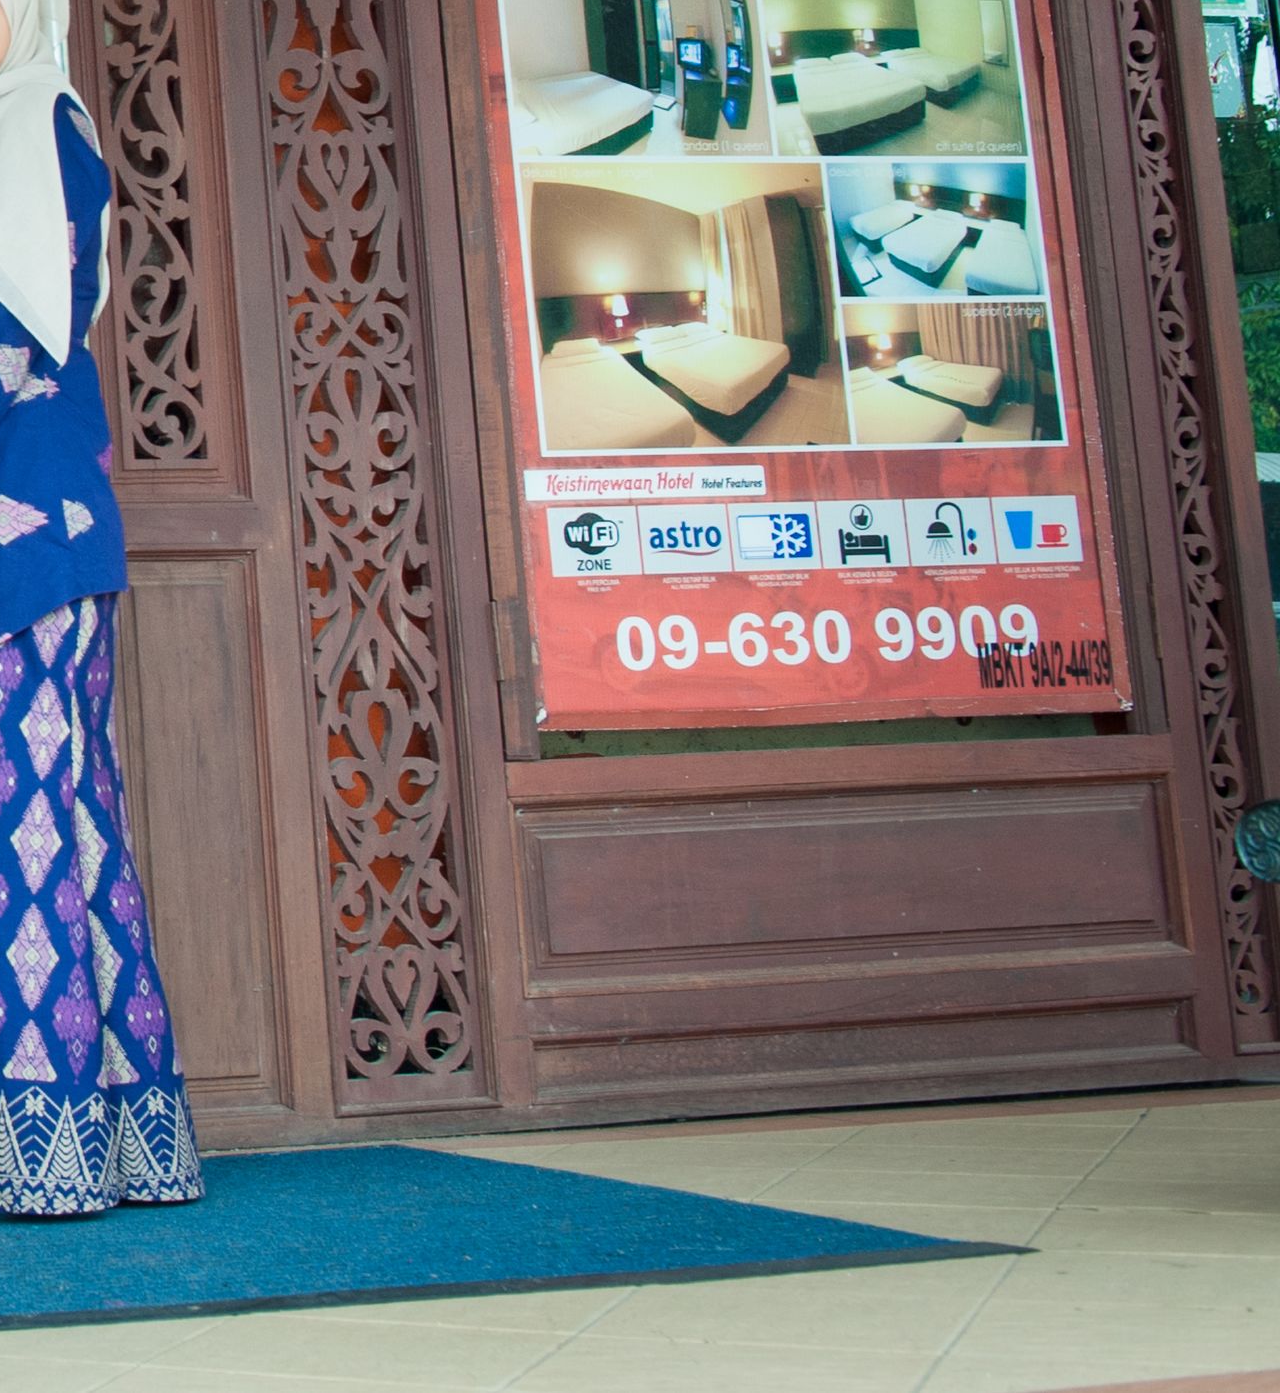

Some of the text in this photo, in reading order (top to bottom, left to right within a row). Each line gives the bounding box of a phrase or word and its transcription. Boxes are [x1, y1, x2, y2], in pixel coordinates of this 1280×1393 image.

[546, 471, 763, 495] Keistimewaan Hotel Hotel Features
[650, 521, 722, 549] astro
[576, 558, 613, 572] ZONE
[615, 603, 1039, 672] 09-630 9909
[977, 642, 1025, 688] MBKT
